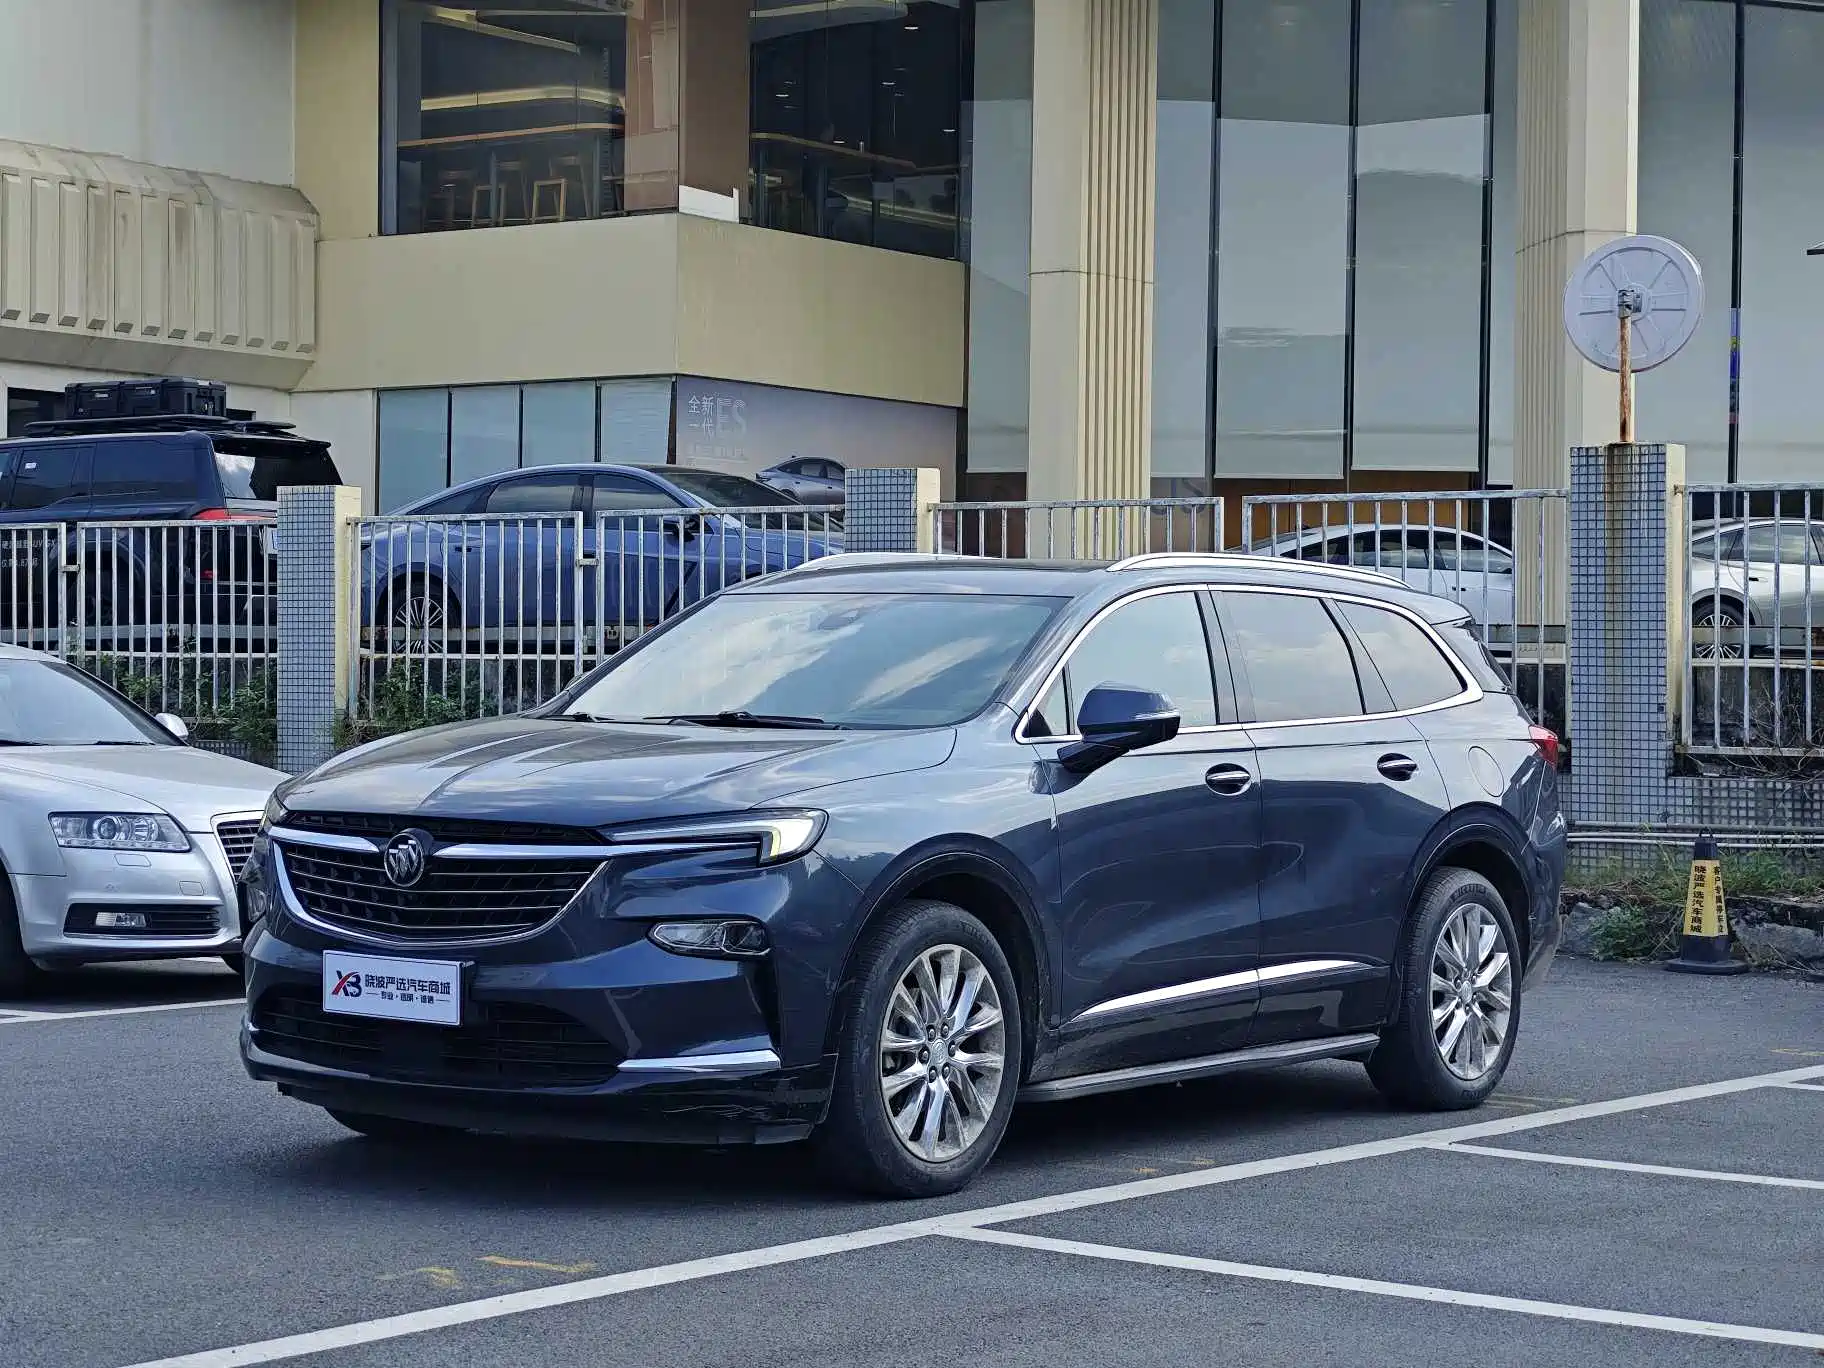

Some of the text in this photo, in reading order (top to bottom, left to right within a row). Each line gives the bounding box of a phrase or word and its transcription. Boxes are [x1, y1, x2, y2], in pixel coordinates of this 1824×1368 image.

[688, 395, 714, 416] 全新
[688, 418, 714, 439] 一代
[365, 974, 451, 995] 晓波严选汽车商城
